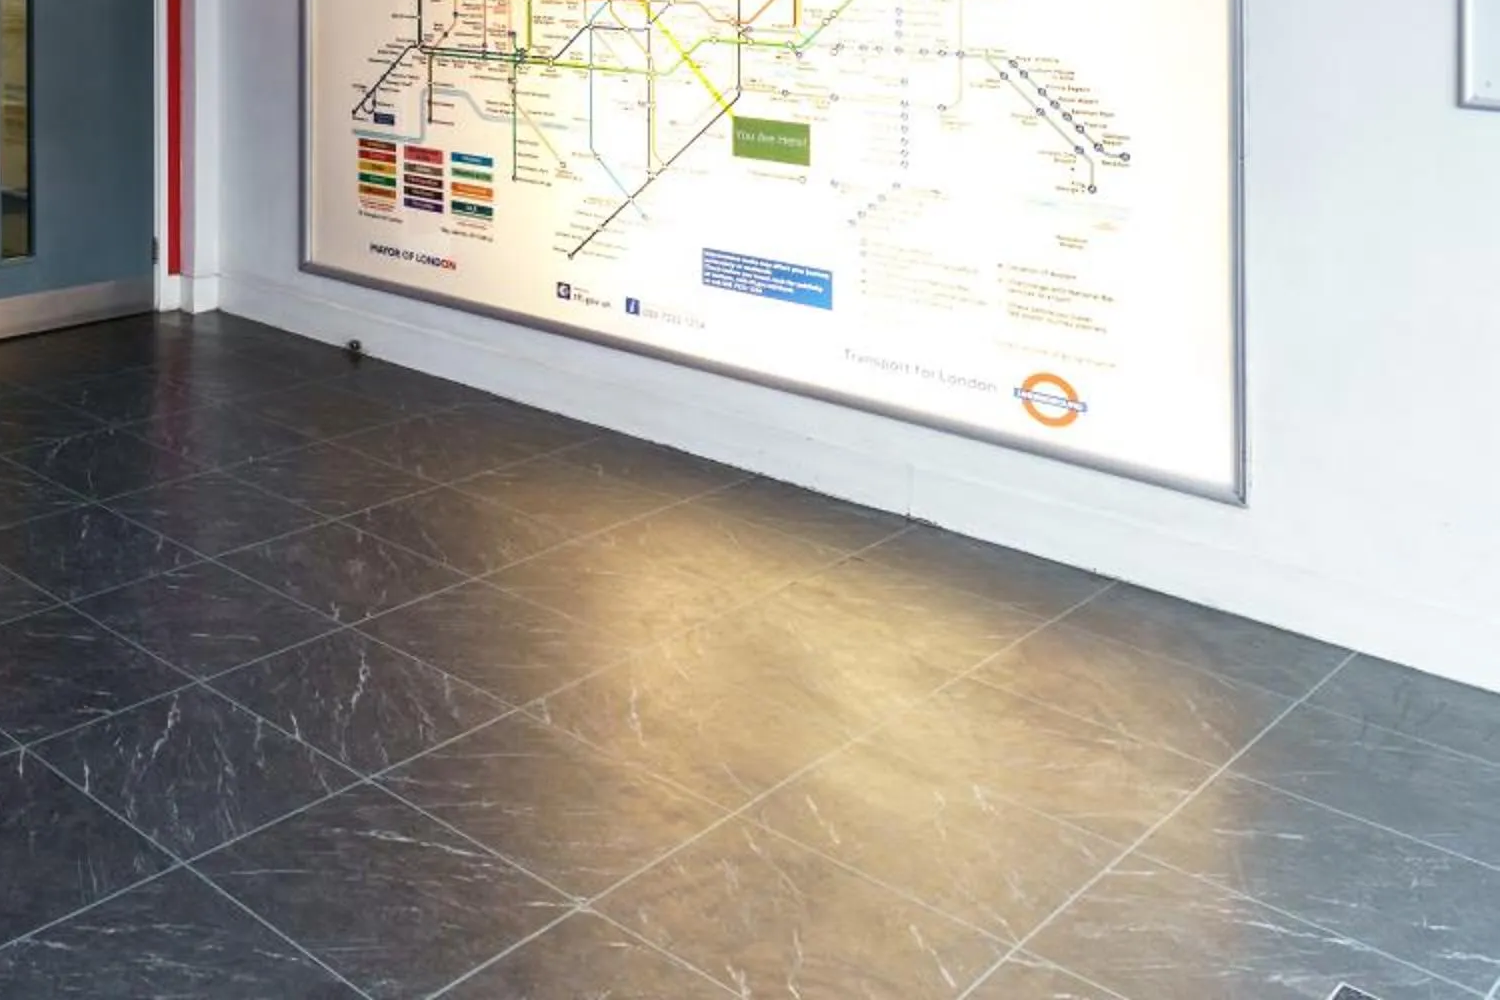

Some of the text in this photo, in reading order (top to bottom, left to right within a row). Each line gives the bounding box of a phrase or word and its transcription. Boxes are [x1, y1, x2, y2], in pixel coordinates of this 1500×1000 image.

[736, 130, 808, 149] You Are Here!
[369, 243, 457, 271] MAYOR OF LONDON
[844, 347, 999, 394] Transport for London
